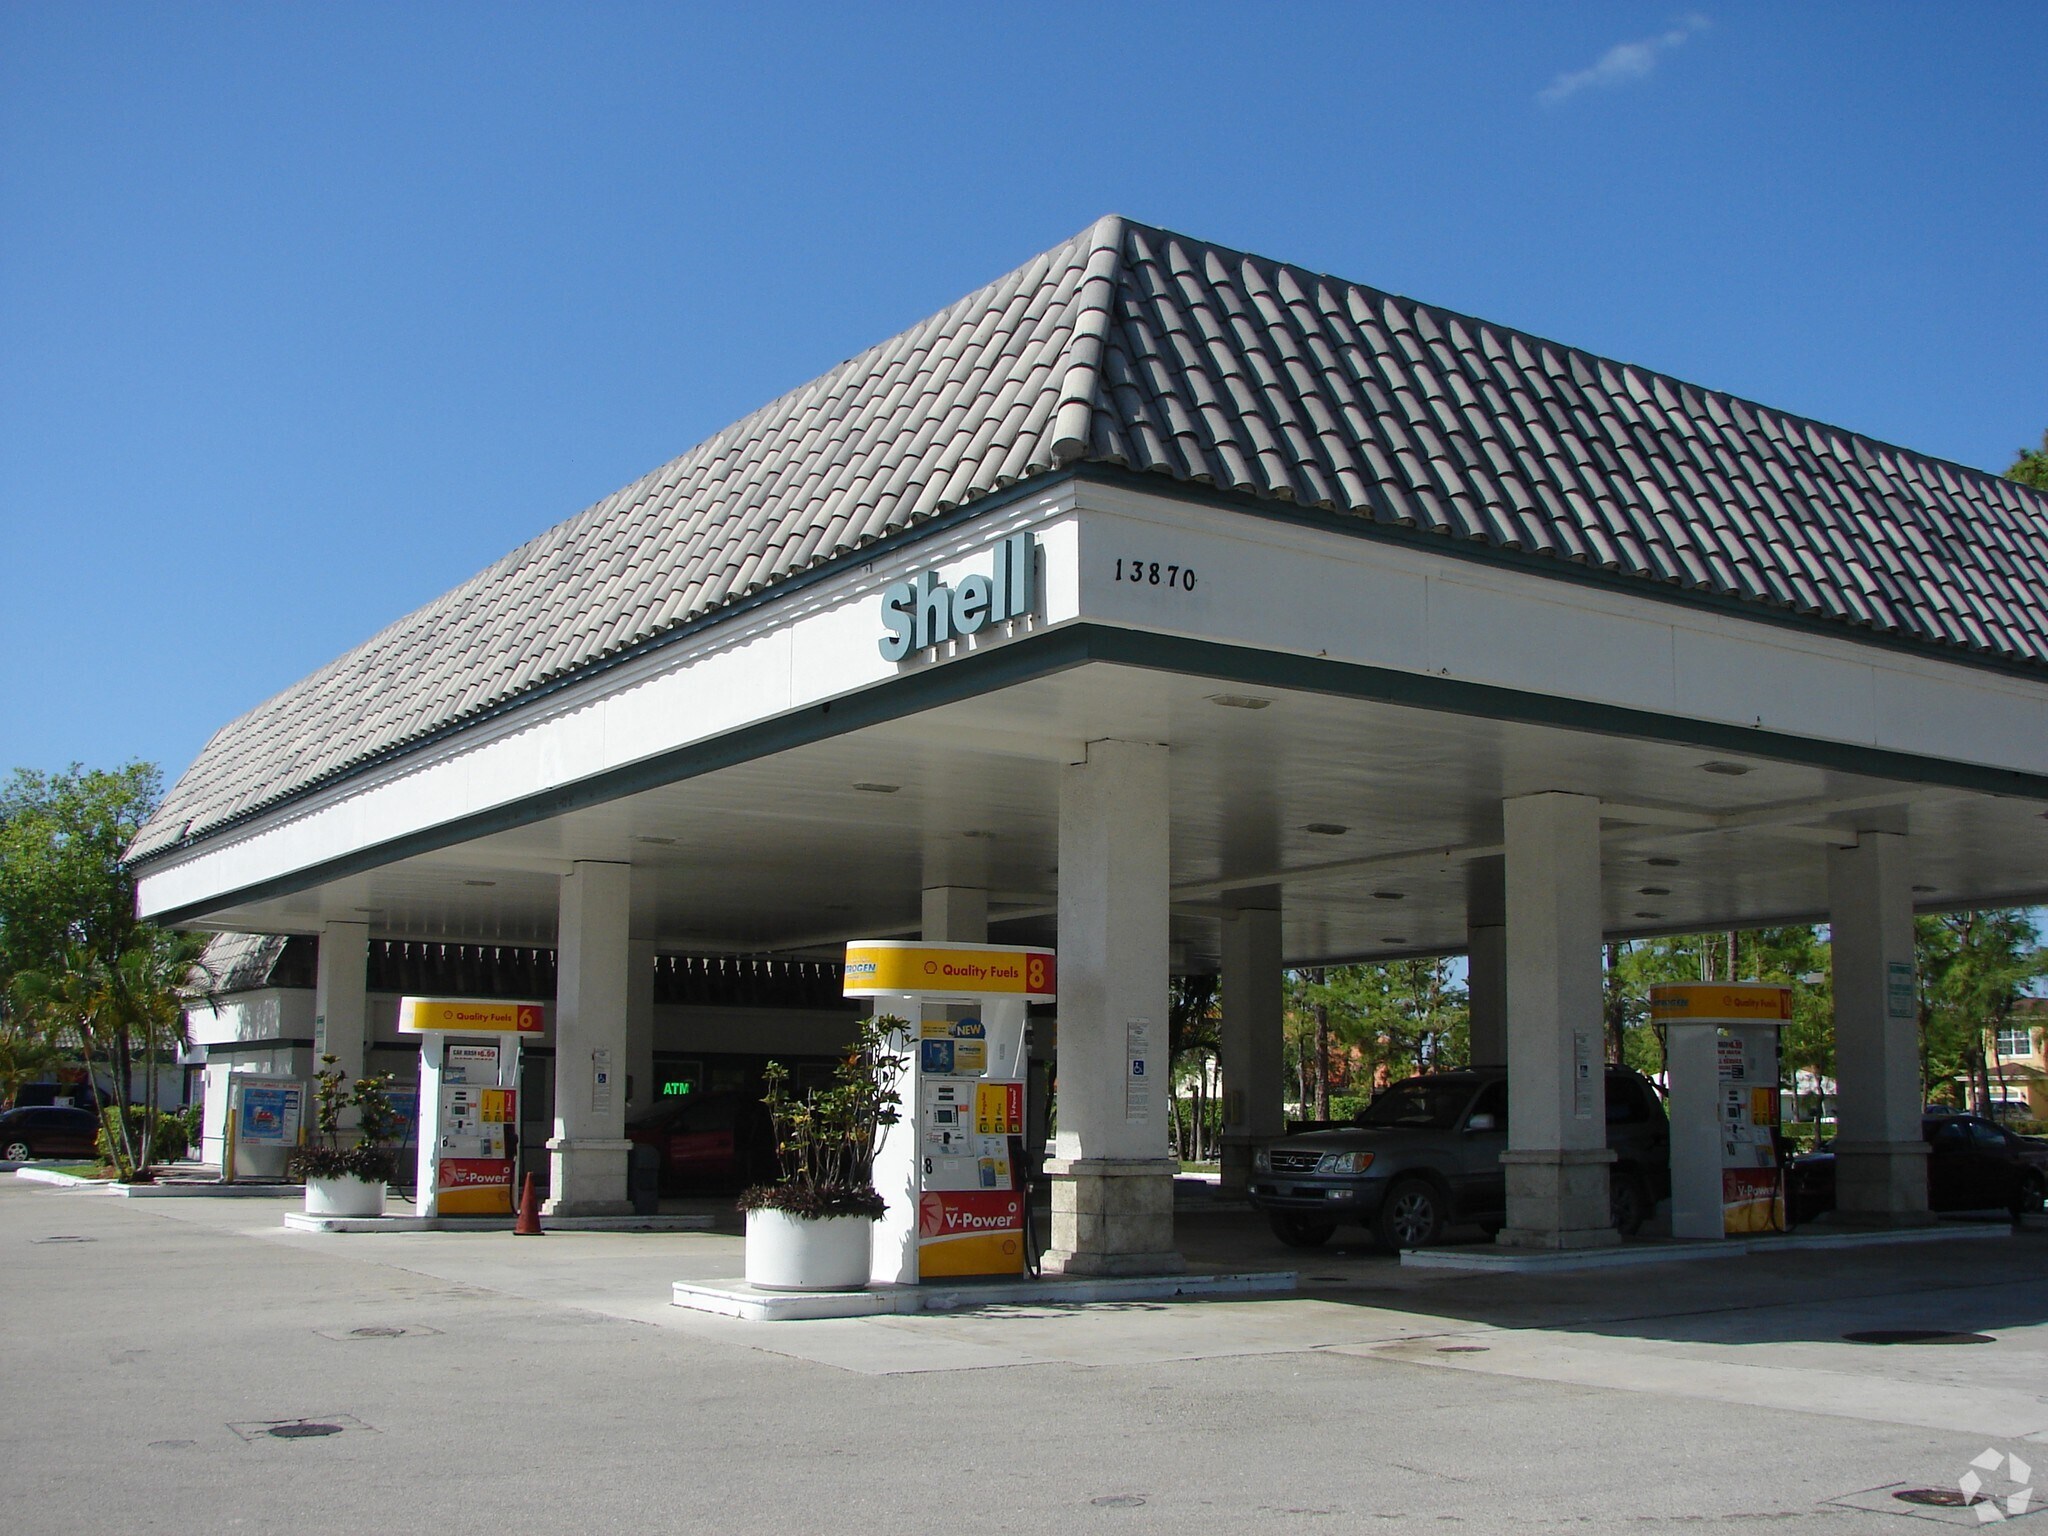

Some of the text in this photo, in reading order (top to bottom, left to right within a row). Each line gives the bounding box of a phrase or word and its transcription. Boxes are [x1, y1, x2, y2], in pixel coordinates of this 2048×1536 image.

[1116, 558, 1195, 591] 13870
[879, 532, 1034, 662] Shell
[943, 964, 1019, 980] Quality Fuels
[1029, 959, 1044, 989] 8
[1734, 998, 1759, 1009] Quality
[456, 1012, 512, 1022] Quality Fuels
[520, 1008, 533, 1028] 6
[957, 1024, 981, 1036] NEW
[663, 1082, 689, 1095] ATM
[925, 1158, 933, 1174] 8
[945, 1212, 1012, 1228] V-Power
